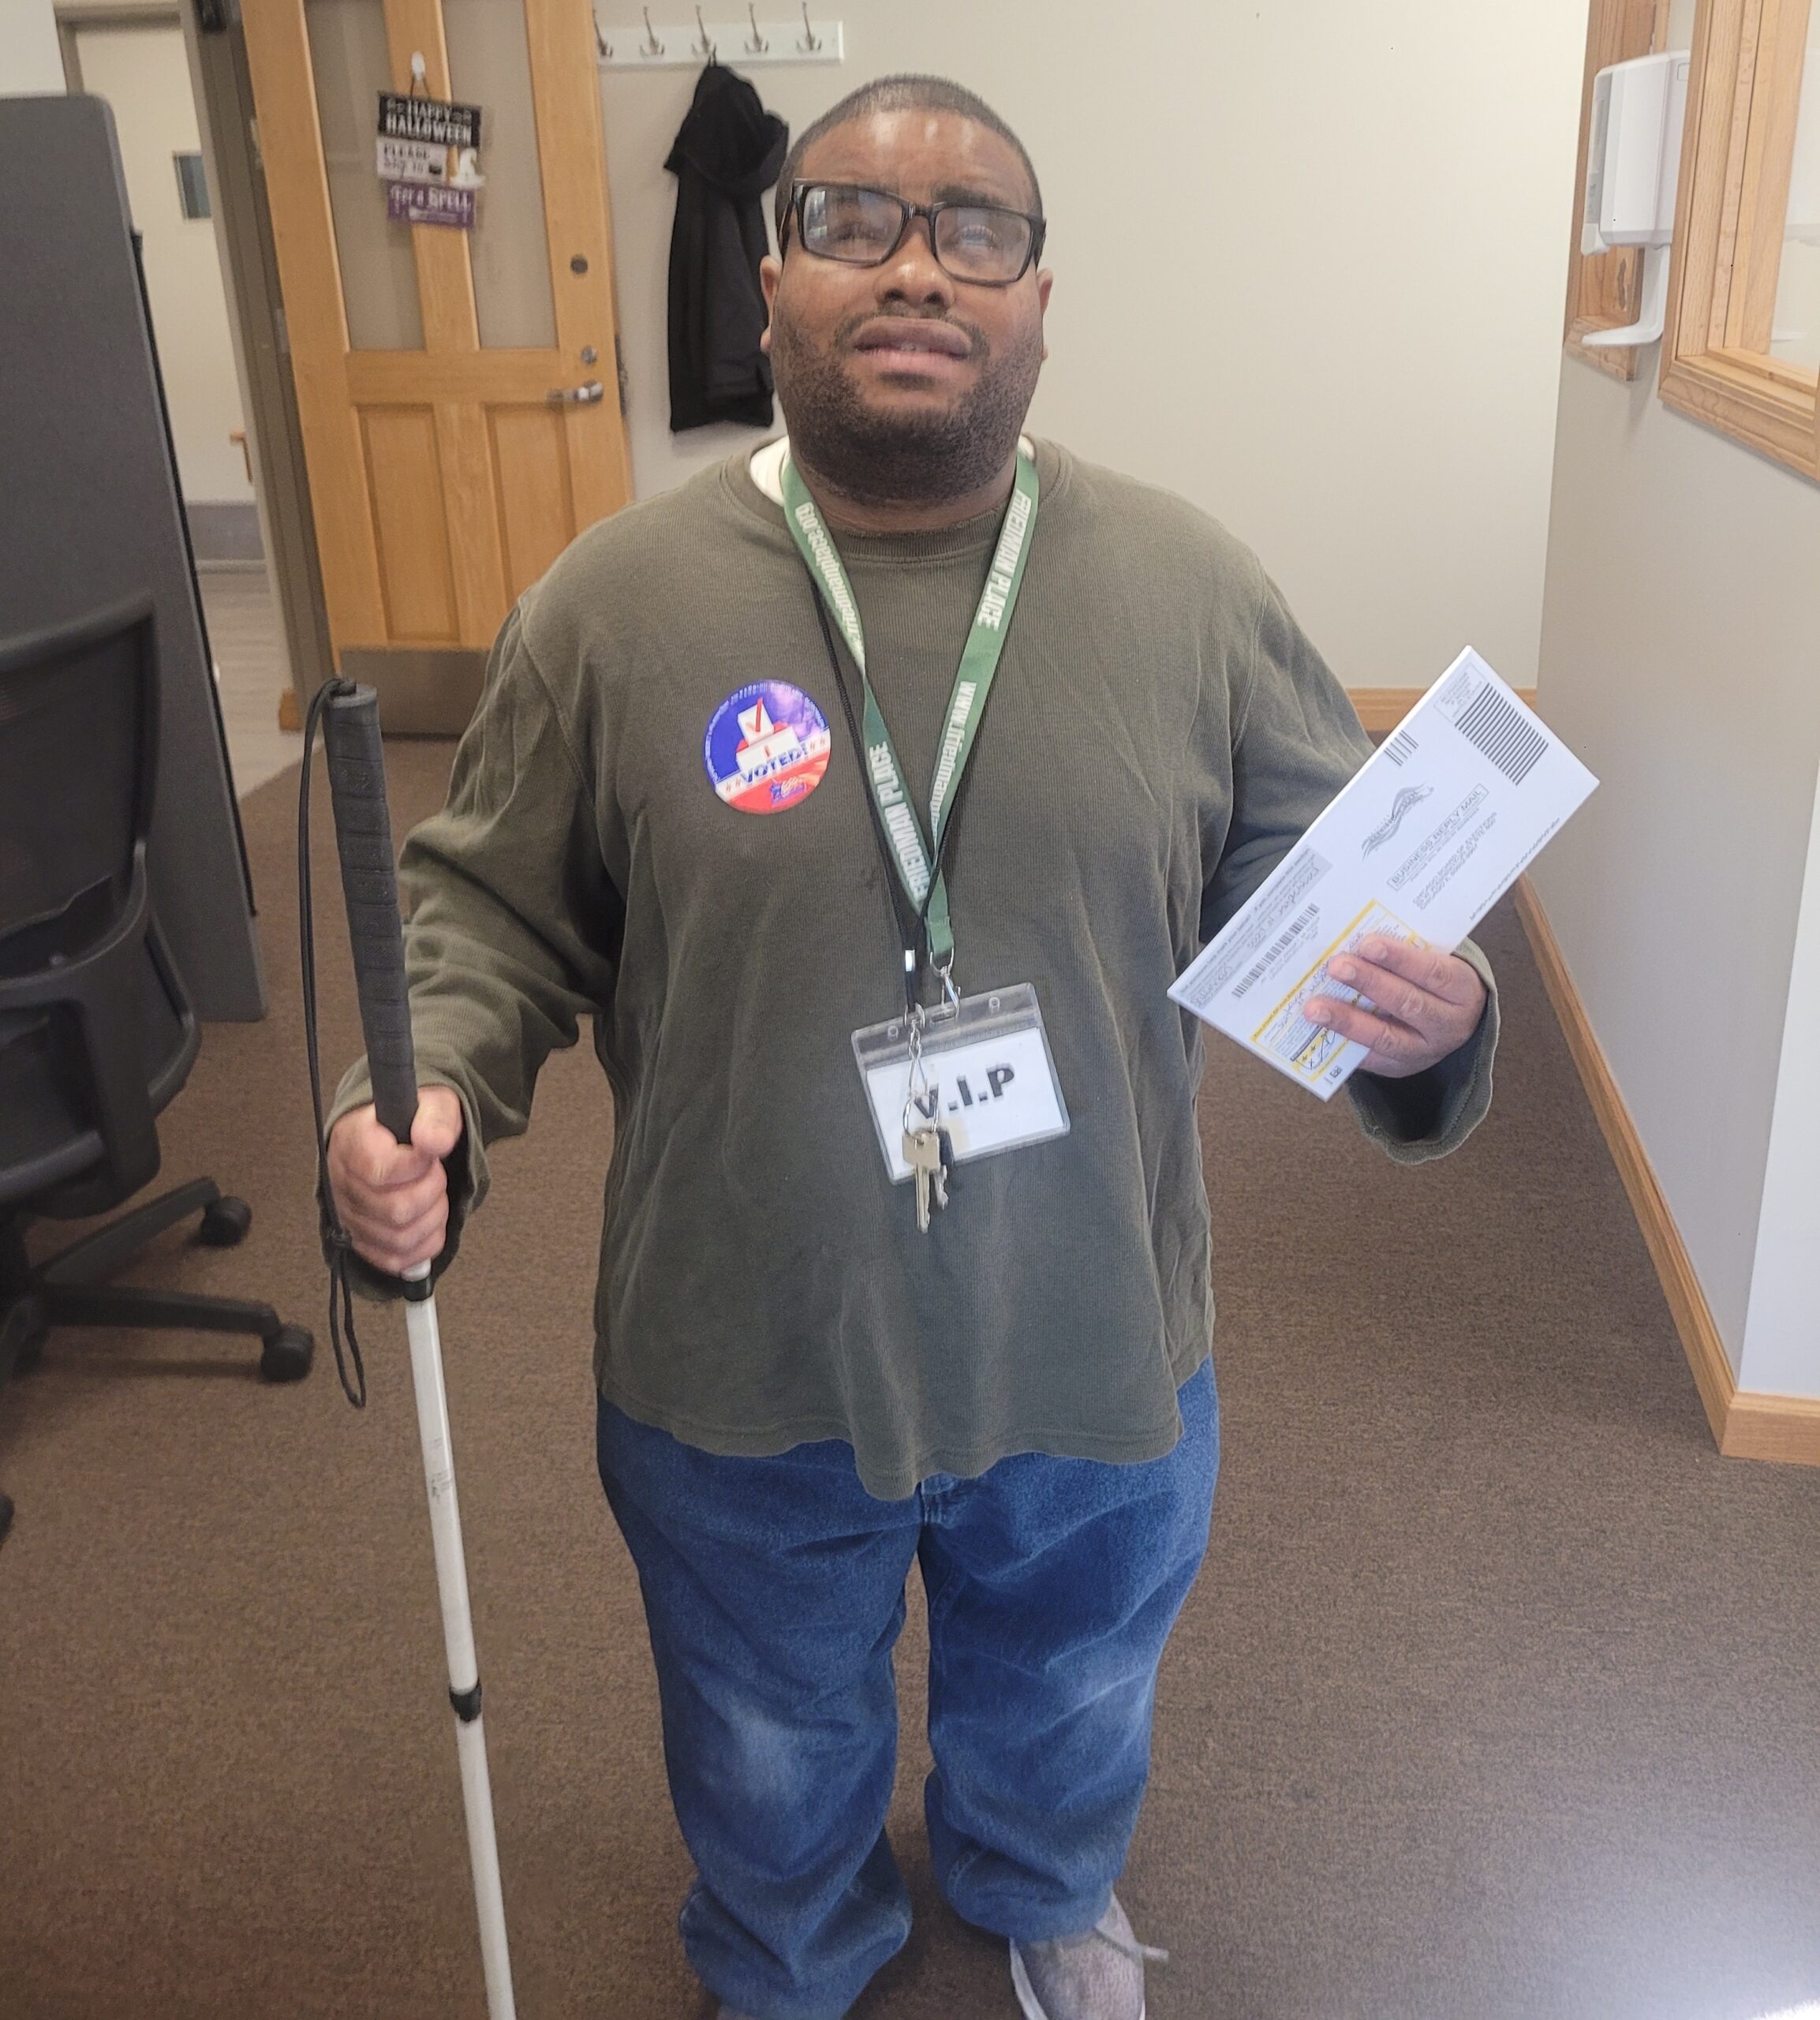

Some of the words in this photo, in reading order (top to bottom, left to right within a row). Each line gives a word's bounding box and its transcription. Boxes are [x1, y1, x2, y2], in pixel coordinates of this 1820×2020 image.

[386, 113, 472, 146] HALLOWEEN
[994, 488, 1032, 577] FRIEDMAN
[977, 570, 1013, 632] PLACE
[740, 744, 809, 784] VOTED!
[869, 739, 903, 806] PLACE
[883, 801, 931, 903] FRIEDMAN
[1390, 838, 1433, 885] BUSINESS
[1431, 810, 1461, 840] REPLY
[1459, 788, 1481, 811] MAIL
[913, 1062, 1015, 1120] V.I.P
